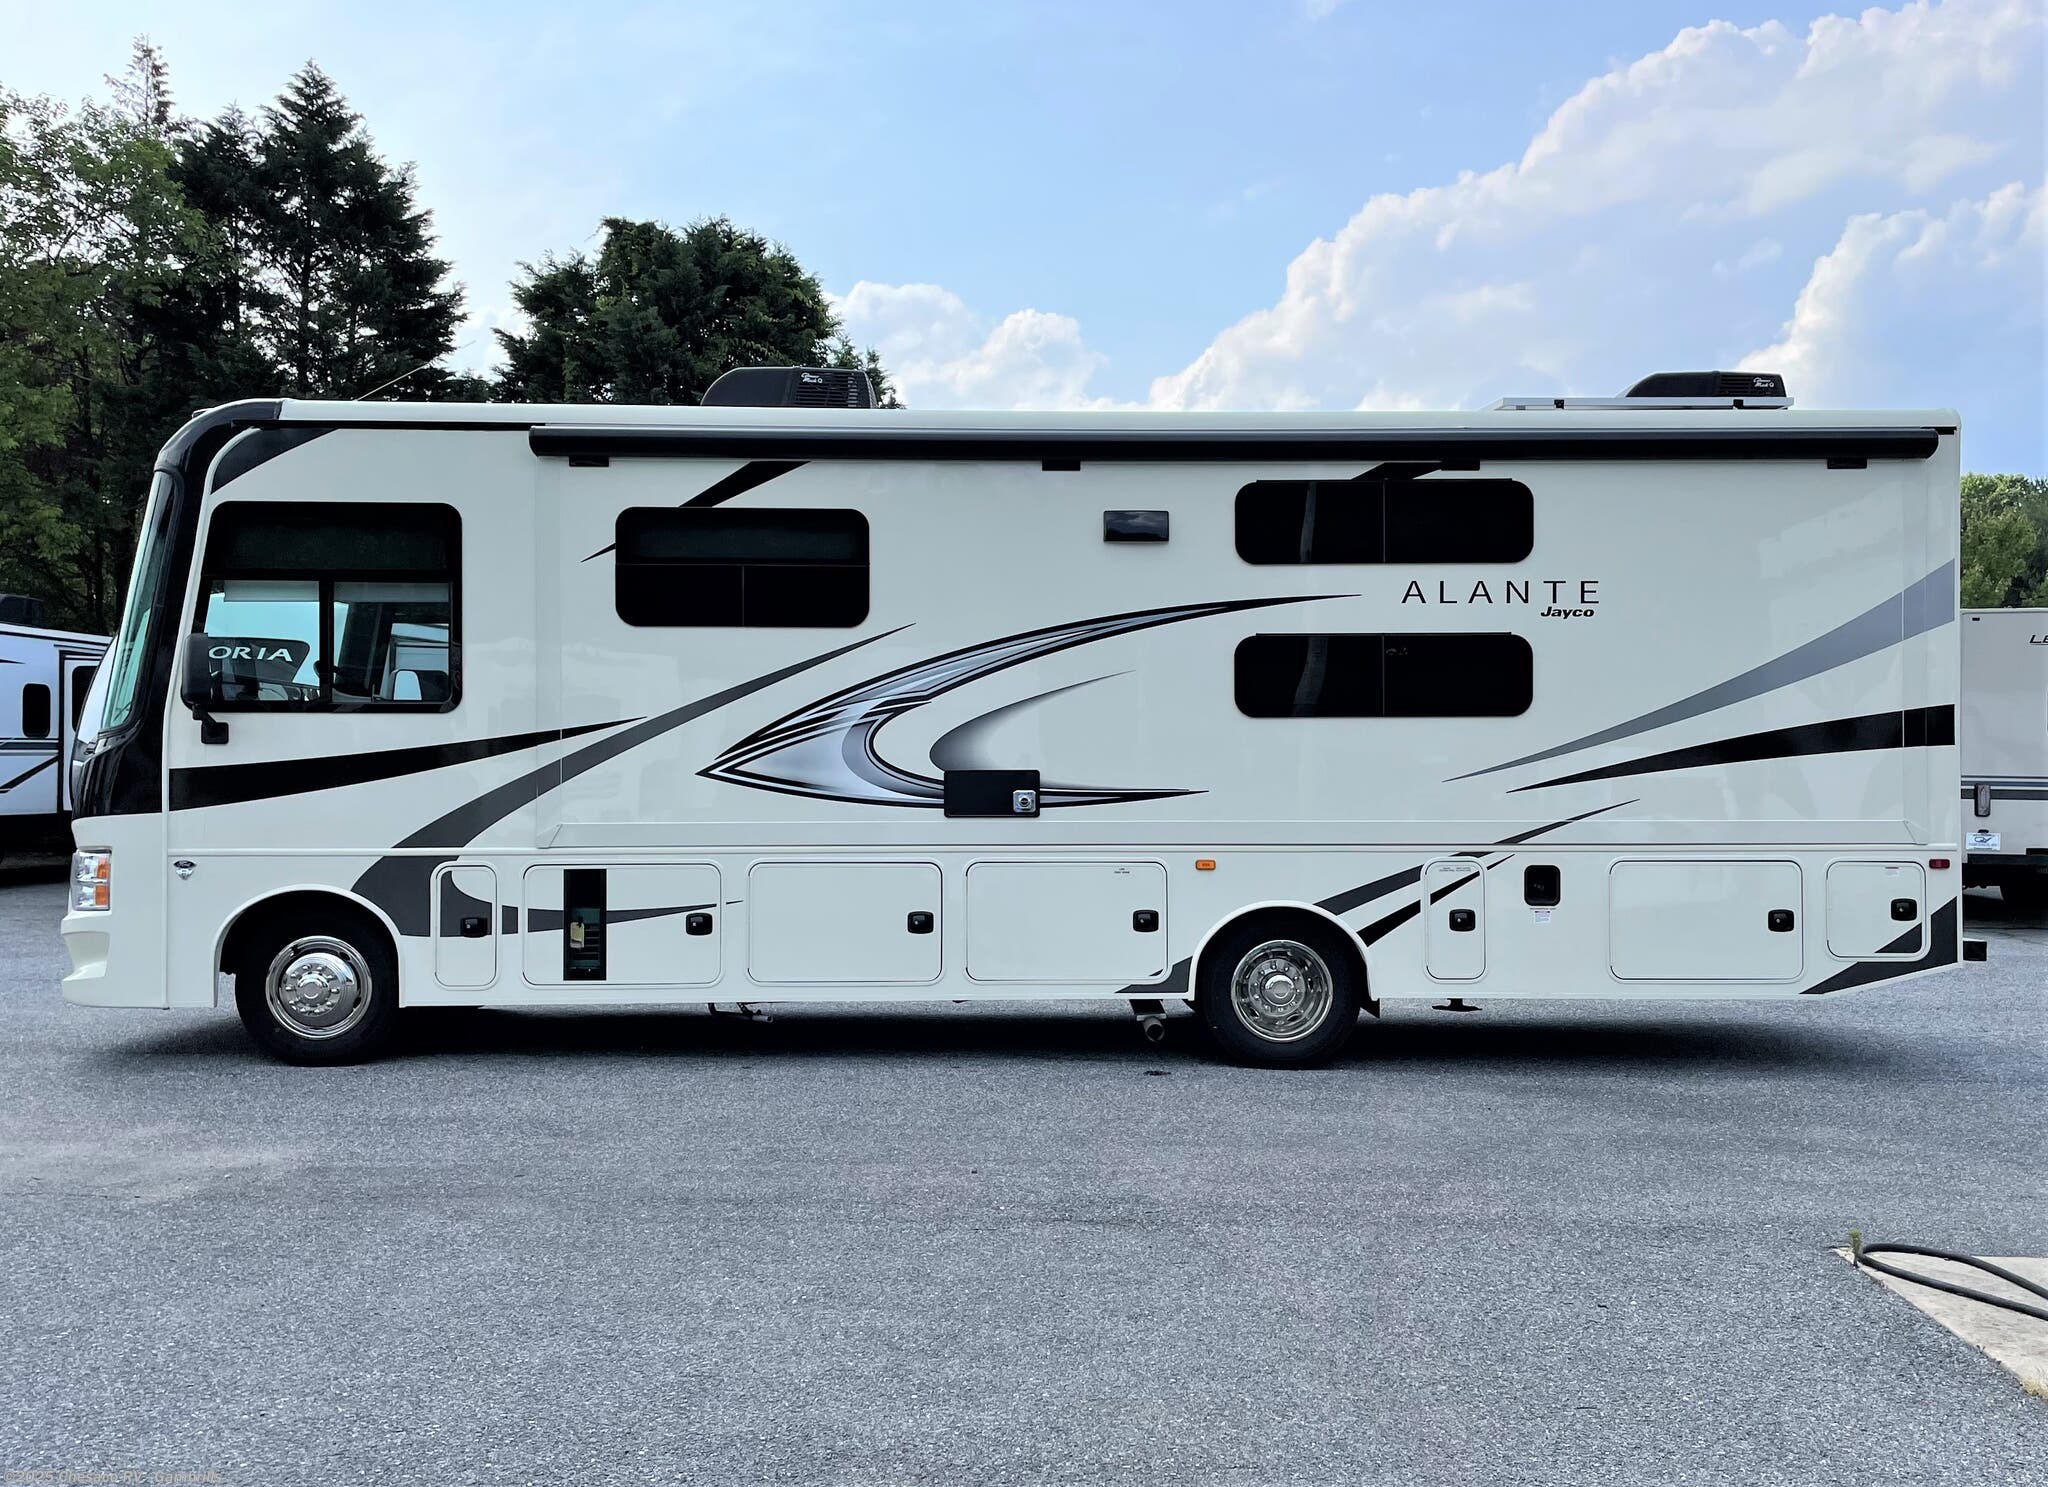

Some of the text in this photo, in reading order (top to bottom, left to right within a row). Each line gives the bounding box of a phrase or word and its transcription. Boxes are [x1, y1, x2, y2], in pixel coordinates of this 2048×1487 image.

[1401, 580, 1600, 604] ALANTE
[1540, 606, 1595, 620] Jayco
[208, 646, 293, 662] ORIA
